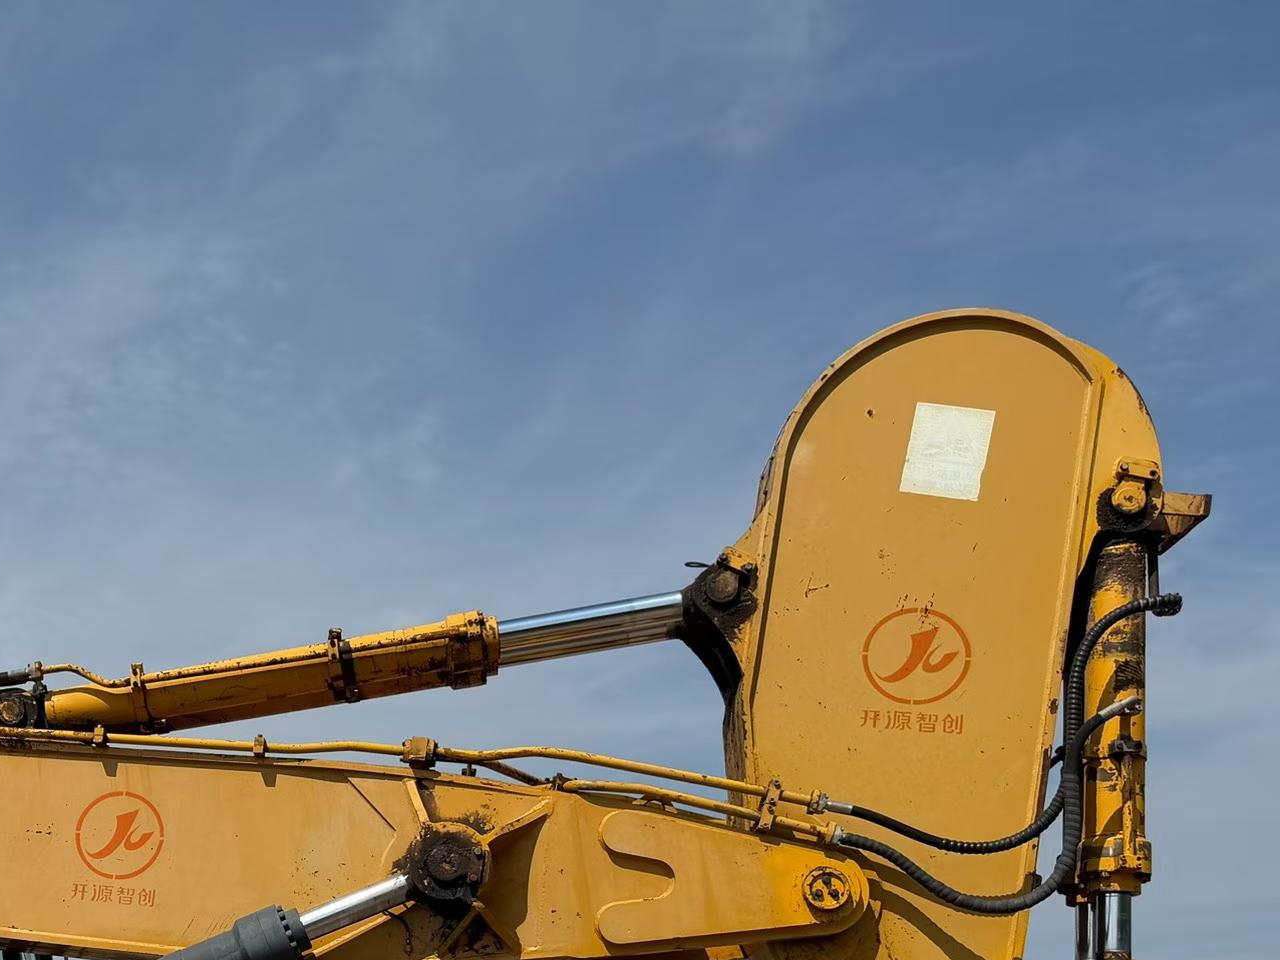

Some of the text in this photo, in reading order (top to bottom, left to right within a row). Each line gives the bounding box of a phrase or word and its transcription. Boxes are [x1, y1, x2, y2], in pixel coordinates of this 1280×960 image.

[859, 709, 964, 735] 开源智创
[71, 882, 157, 907] 开源智创
